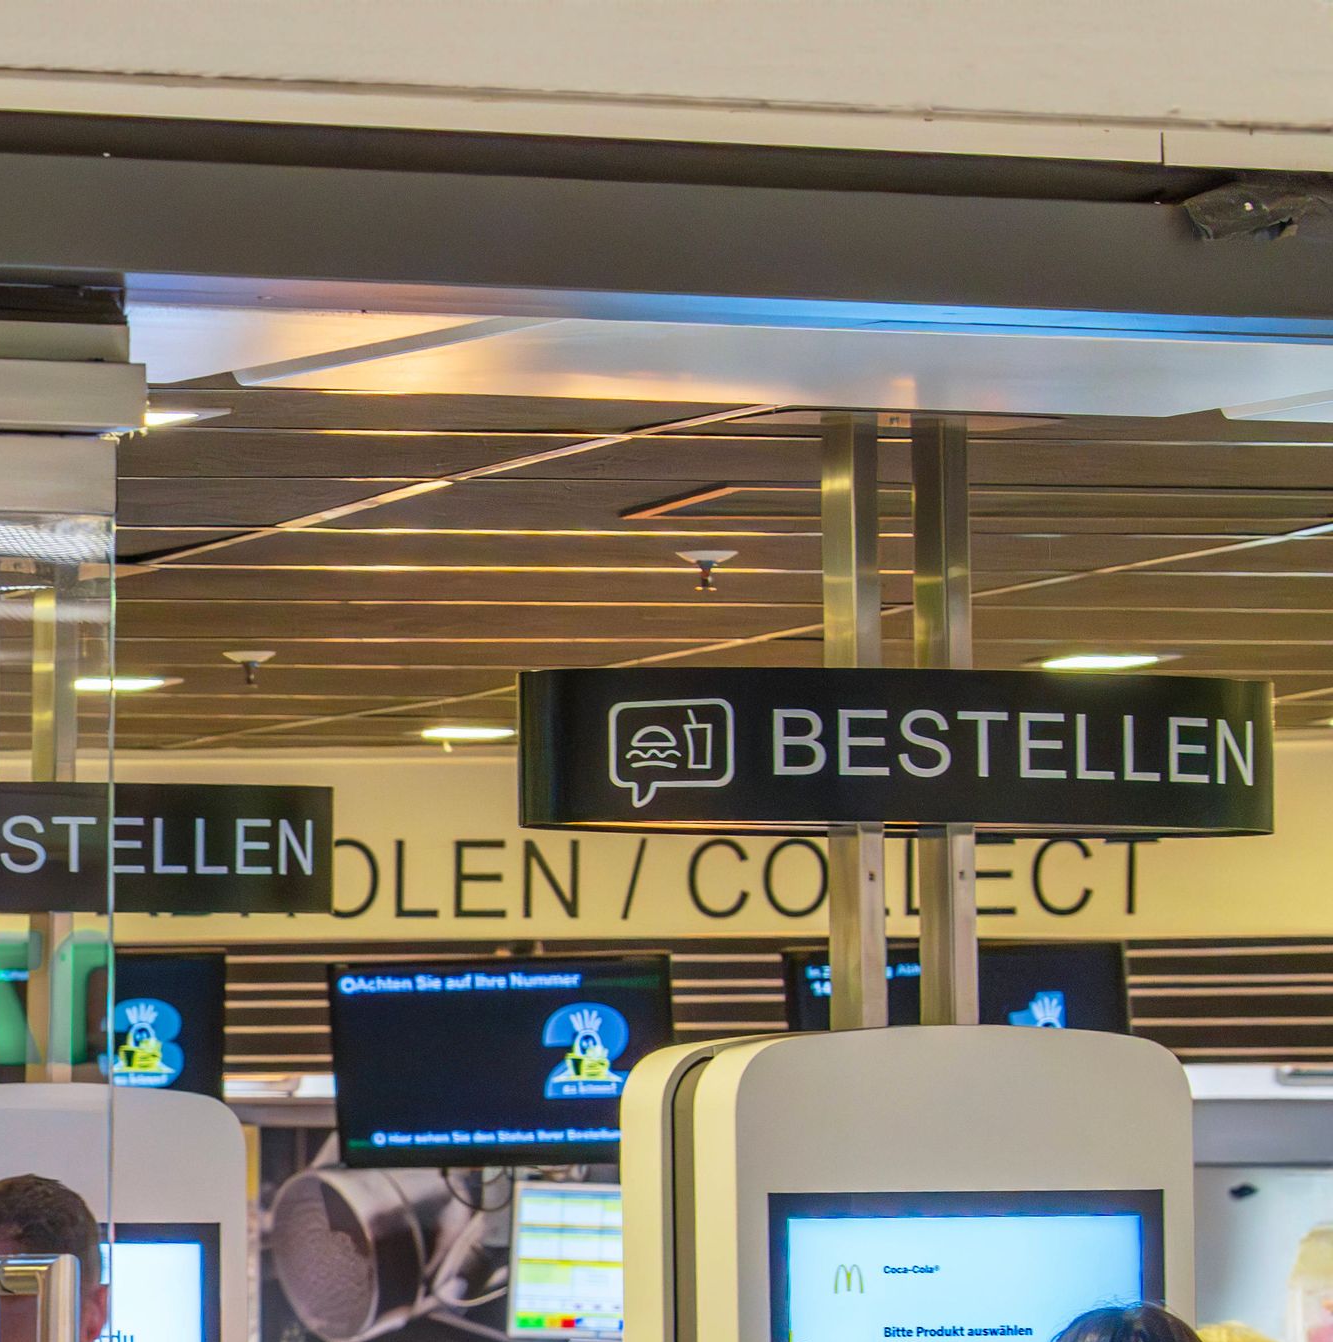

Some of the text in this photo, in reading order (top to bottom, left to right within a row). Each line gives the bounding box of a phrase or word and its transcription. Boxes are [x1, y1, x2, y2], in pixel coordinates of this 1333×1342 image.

[771, 707, 1255, 788] BESTELLEN
[331, 836, 580, 919] OLEN
[688, 837, 1161, 919] COLECT
[355, 971, 582, 993] Achten Sie auf Ihre Nummer
[884, 1325, 1033, 1338] Bitte Produkt auswählen
